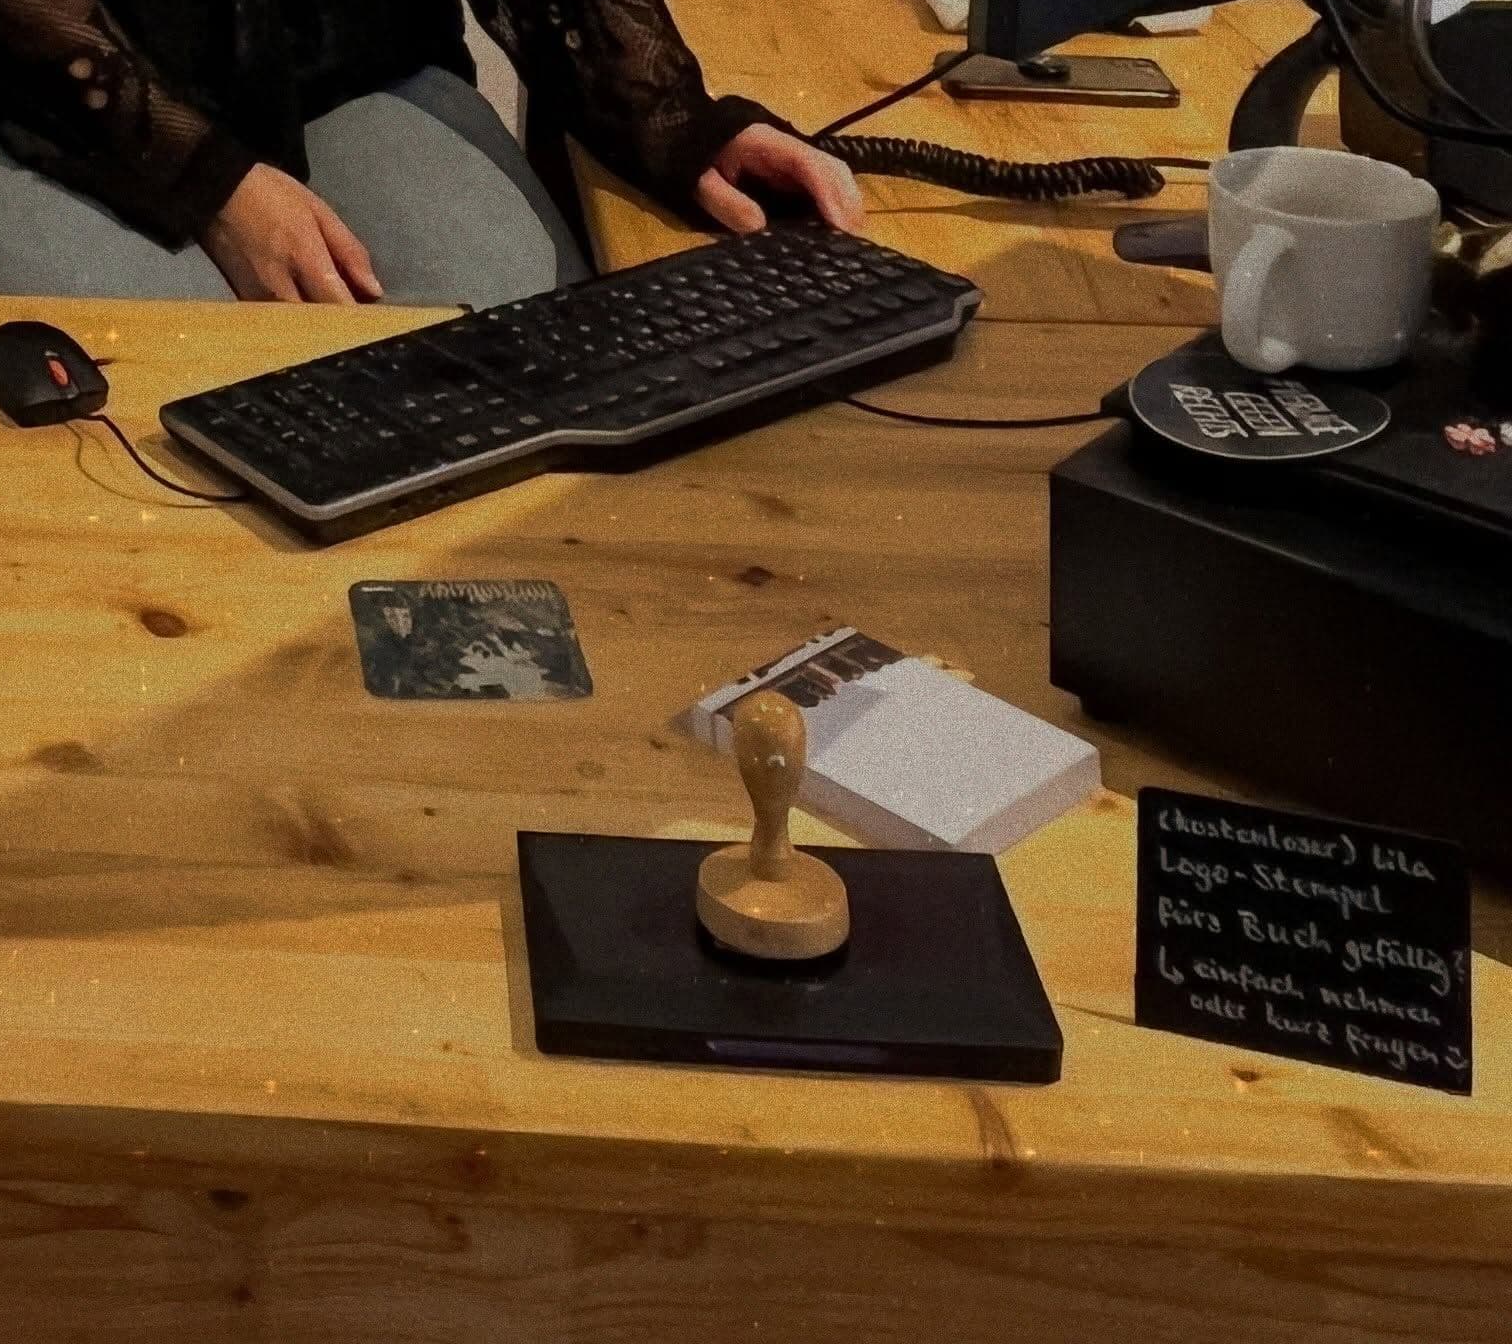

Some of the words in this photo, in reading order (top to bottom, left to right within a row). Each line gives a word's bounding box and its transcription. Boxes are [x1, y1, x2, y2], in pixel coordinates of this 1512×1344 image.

[1157, 809, 1357, 865] (kostenloser)
[1237, 909, 1332, 953] Buch
[1192, 956, 1306, 1001] einfach
[1189, 993, 1247, 1021] oder
[1345, 1022, 1440, 1069] fragen
